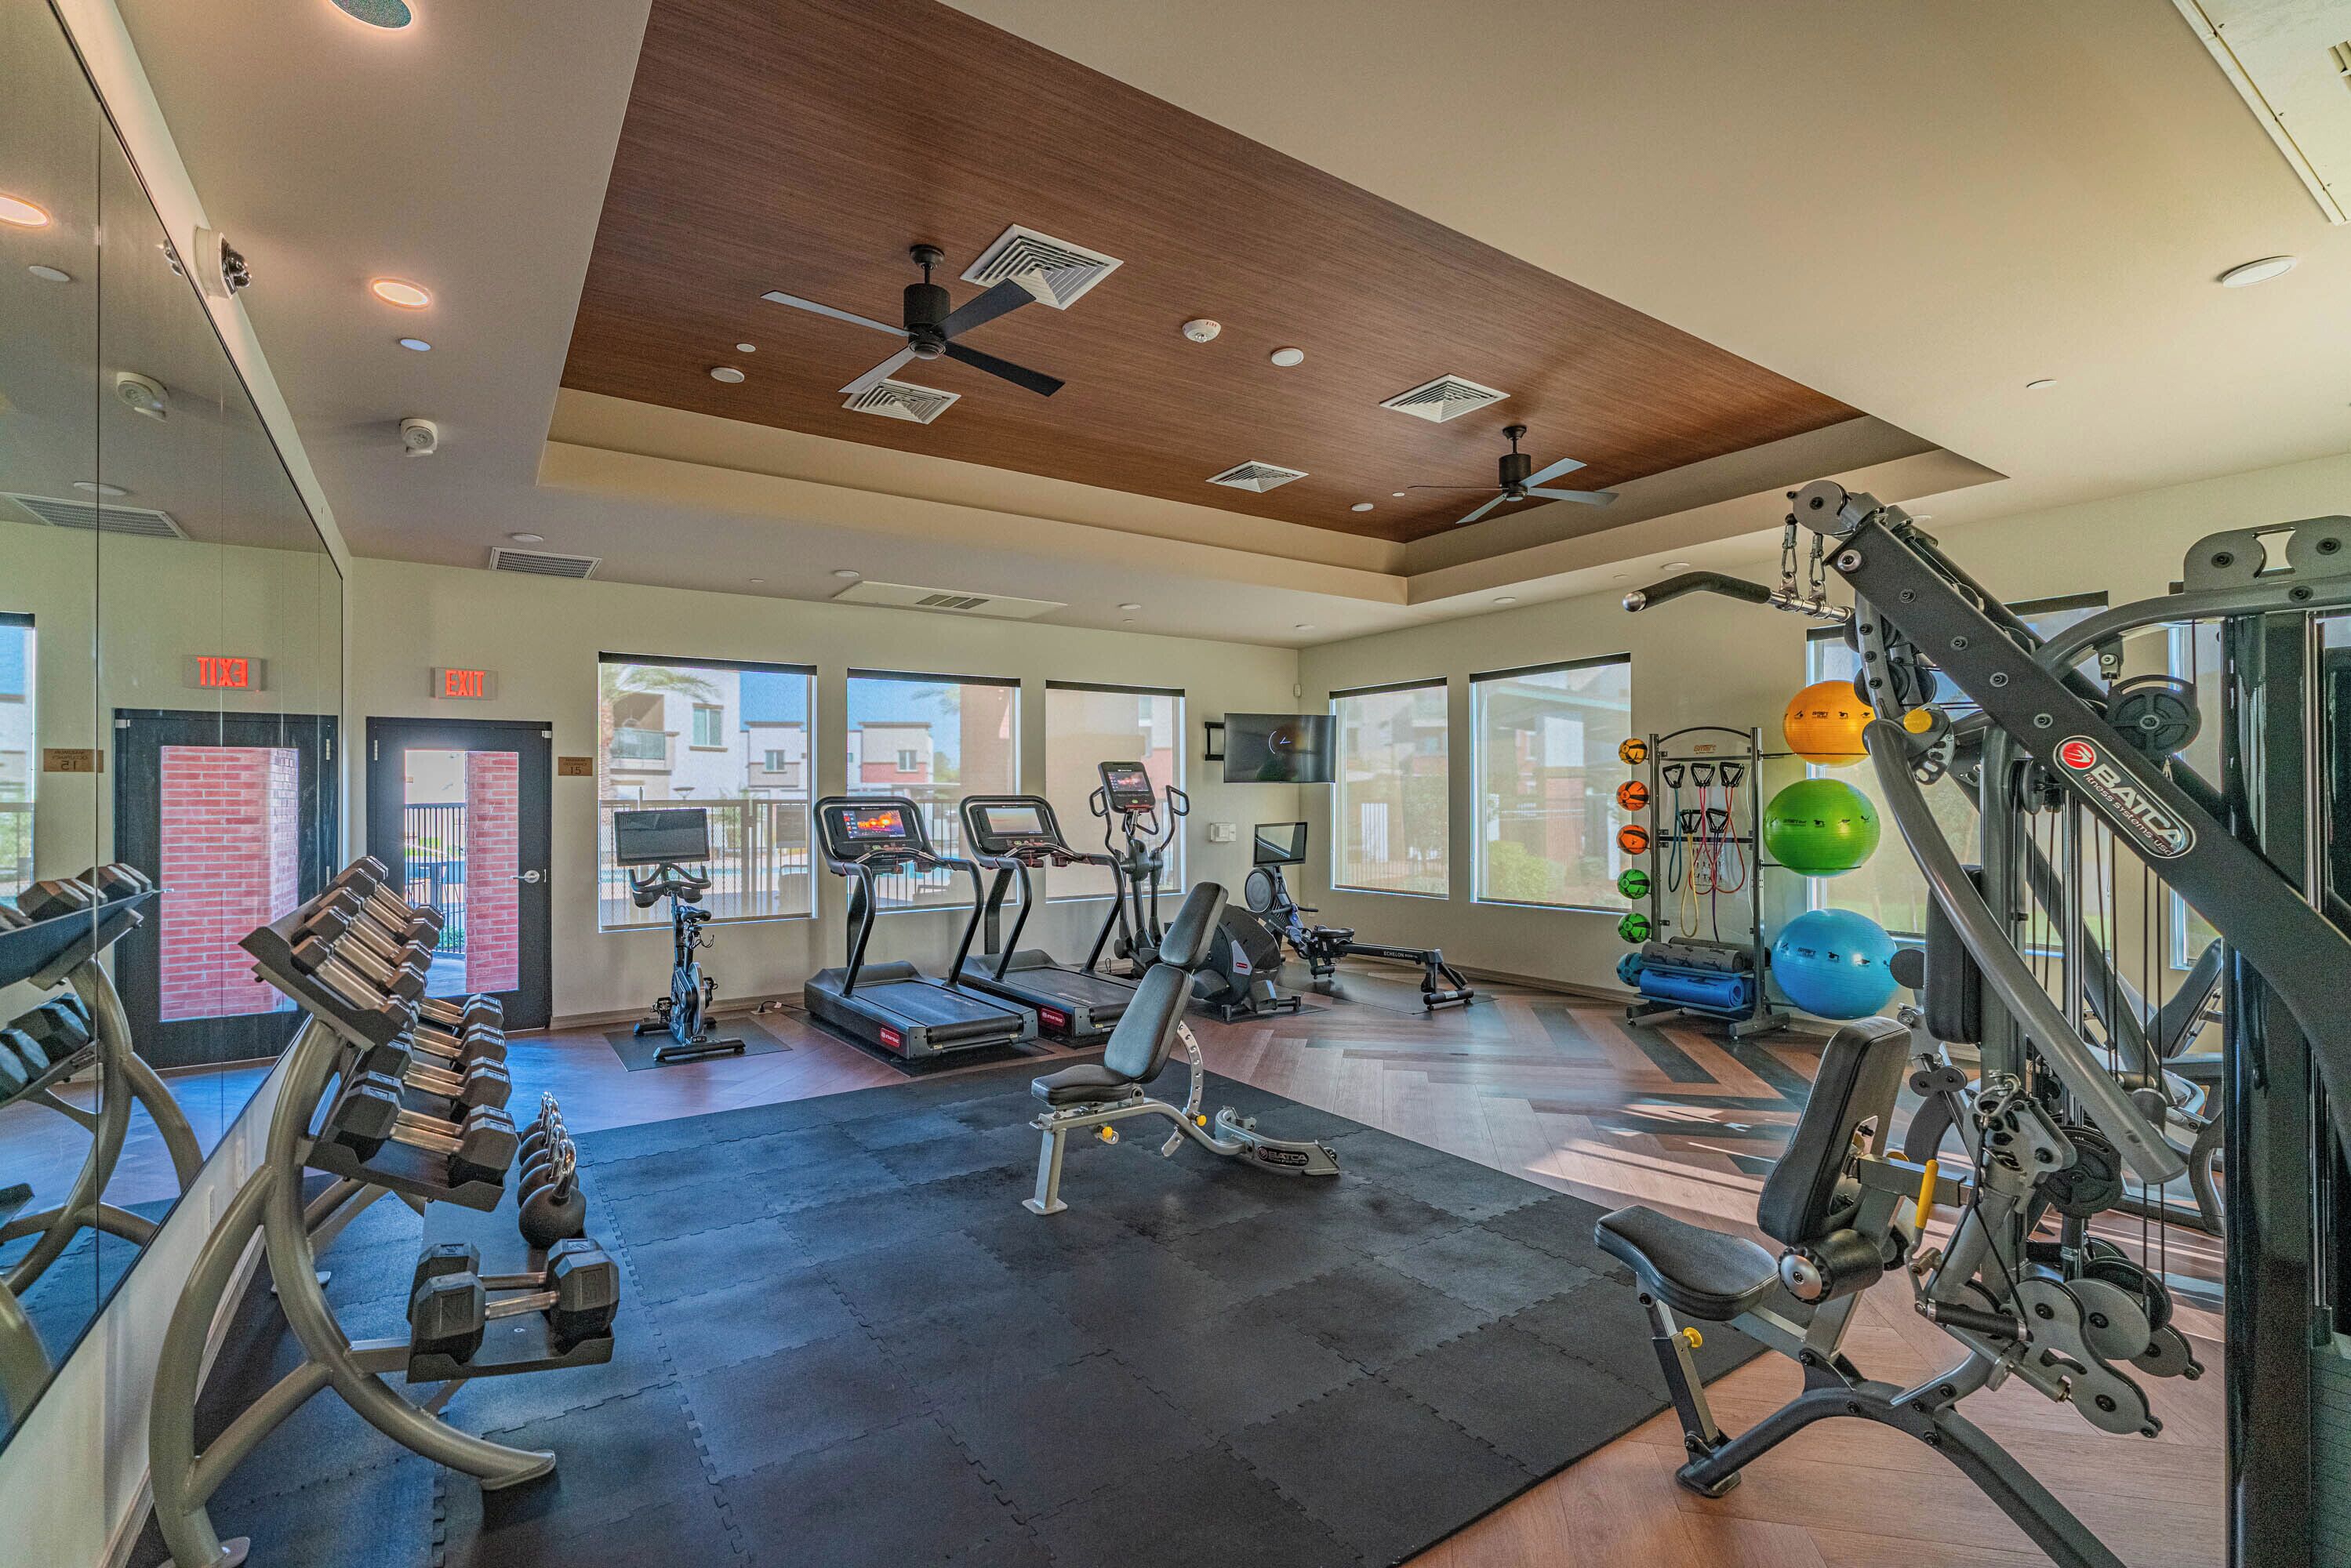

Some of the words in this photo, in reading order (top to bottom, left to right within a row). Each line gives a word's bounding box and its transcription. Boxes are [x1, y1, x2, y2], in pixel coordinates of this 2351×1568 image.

[445, 670, 485, 697] EXIT
[571, 766, 582, 775] 15
[2083, 772, 2115, 802] fitness
[2089, 764, 2183, 847] BATCA
[1268, 1151, 1307, 1161] BATCA
